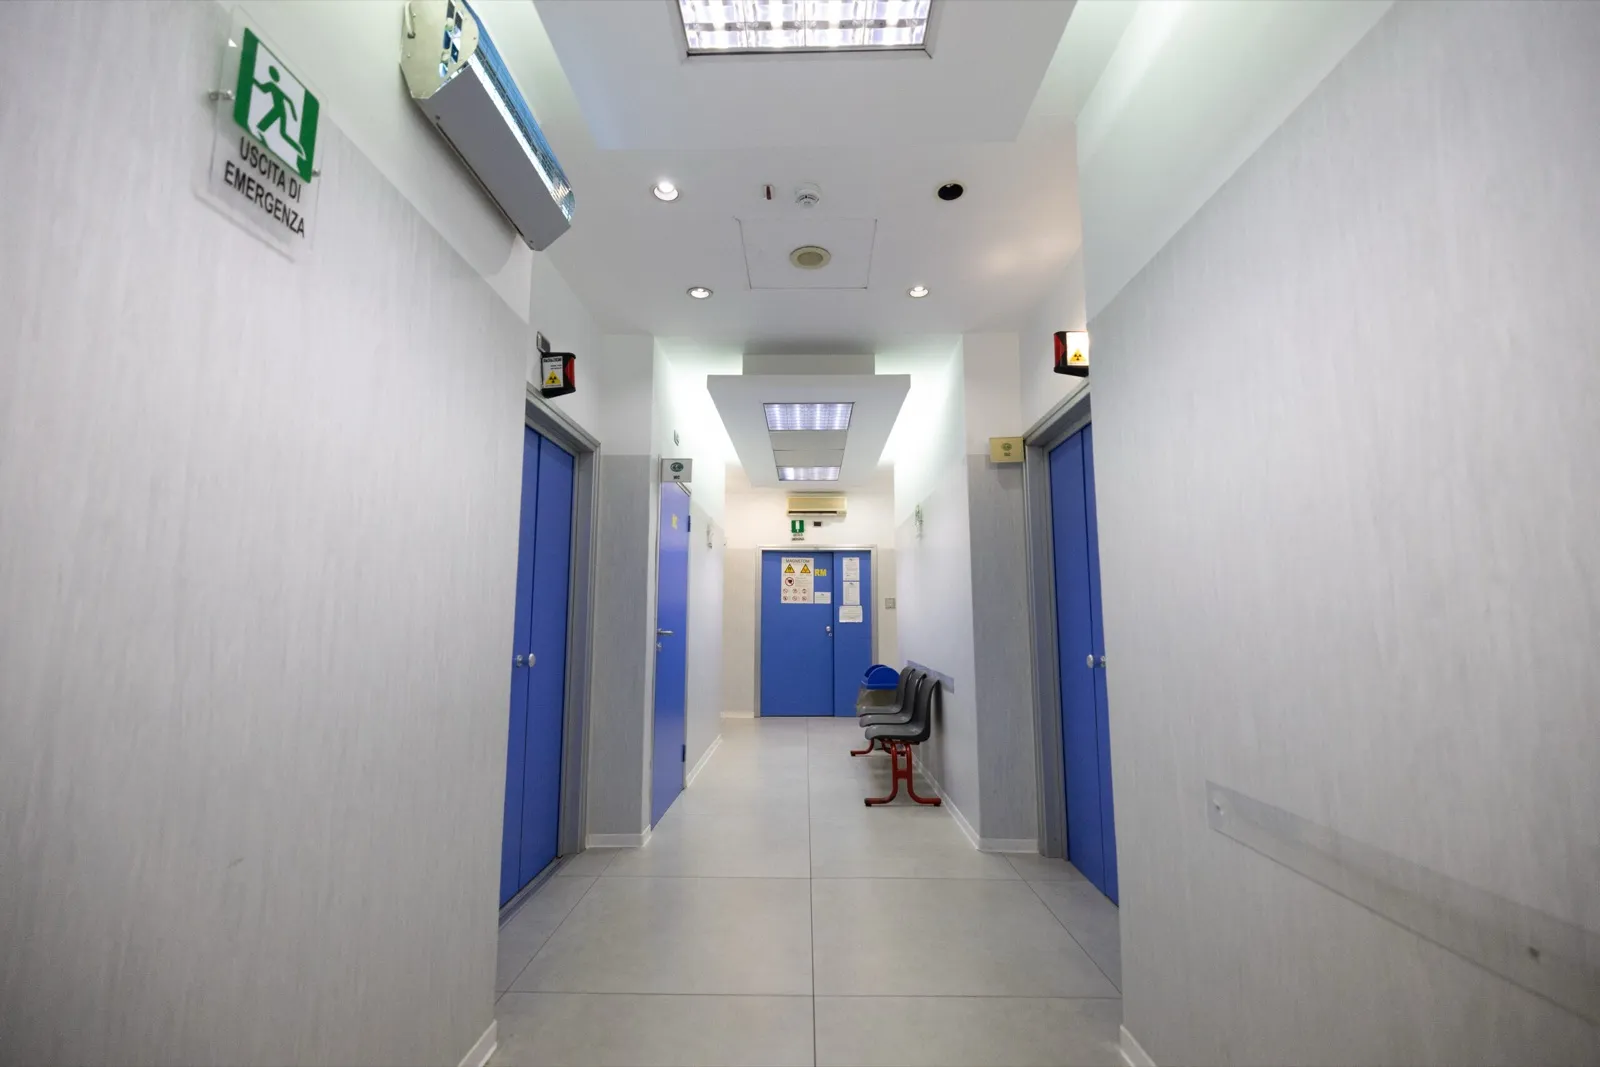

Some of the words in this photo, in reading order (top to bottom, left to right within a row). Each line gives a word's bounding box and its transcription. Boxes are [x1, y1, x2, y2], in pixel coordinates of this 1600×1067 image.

[224, 160, 305, 239] EMERGENZA
[240, 136, 286, 193] USCITA
[288, 178, 302, 204] DI
[814, 569, 827, 577] RM
